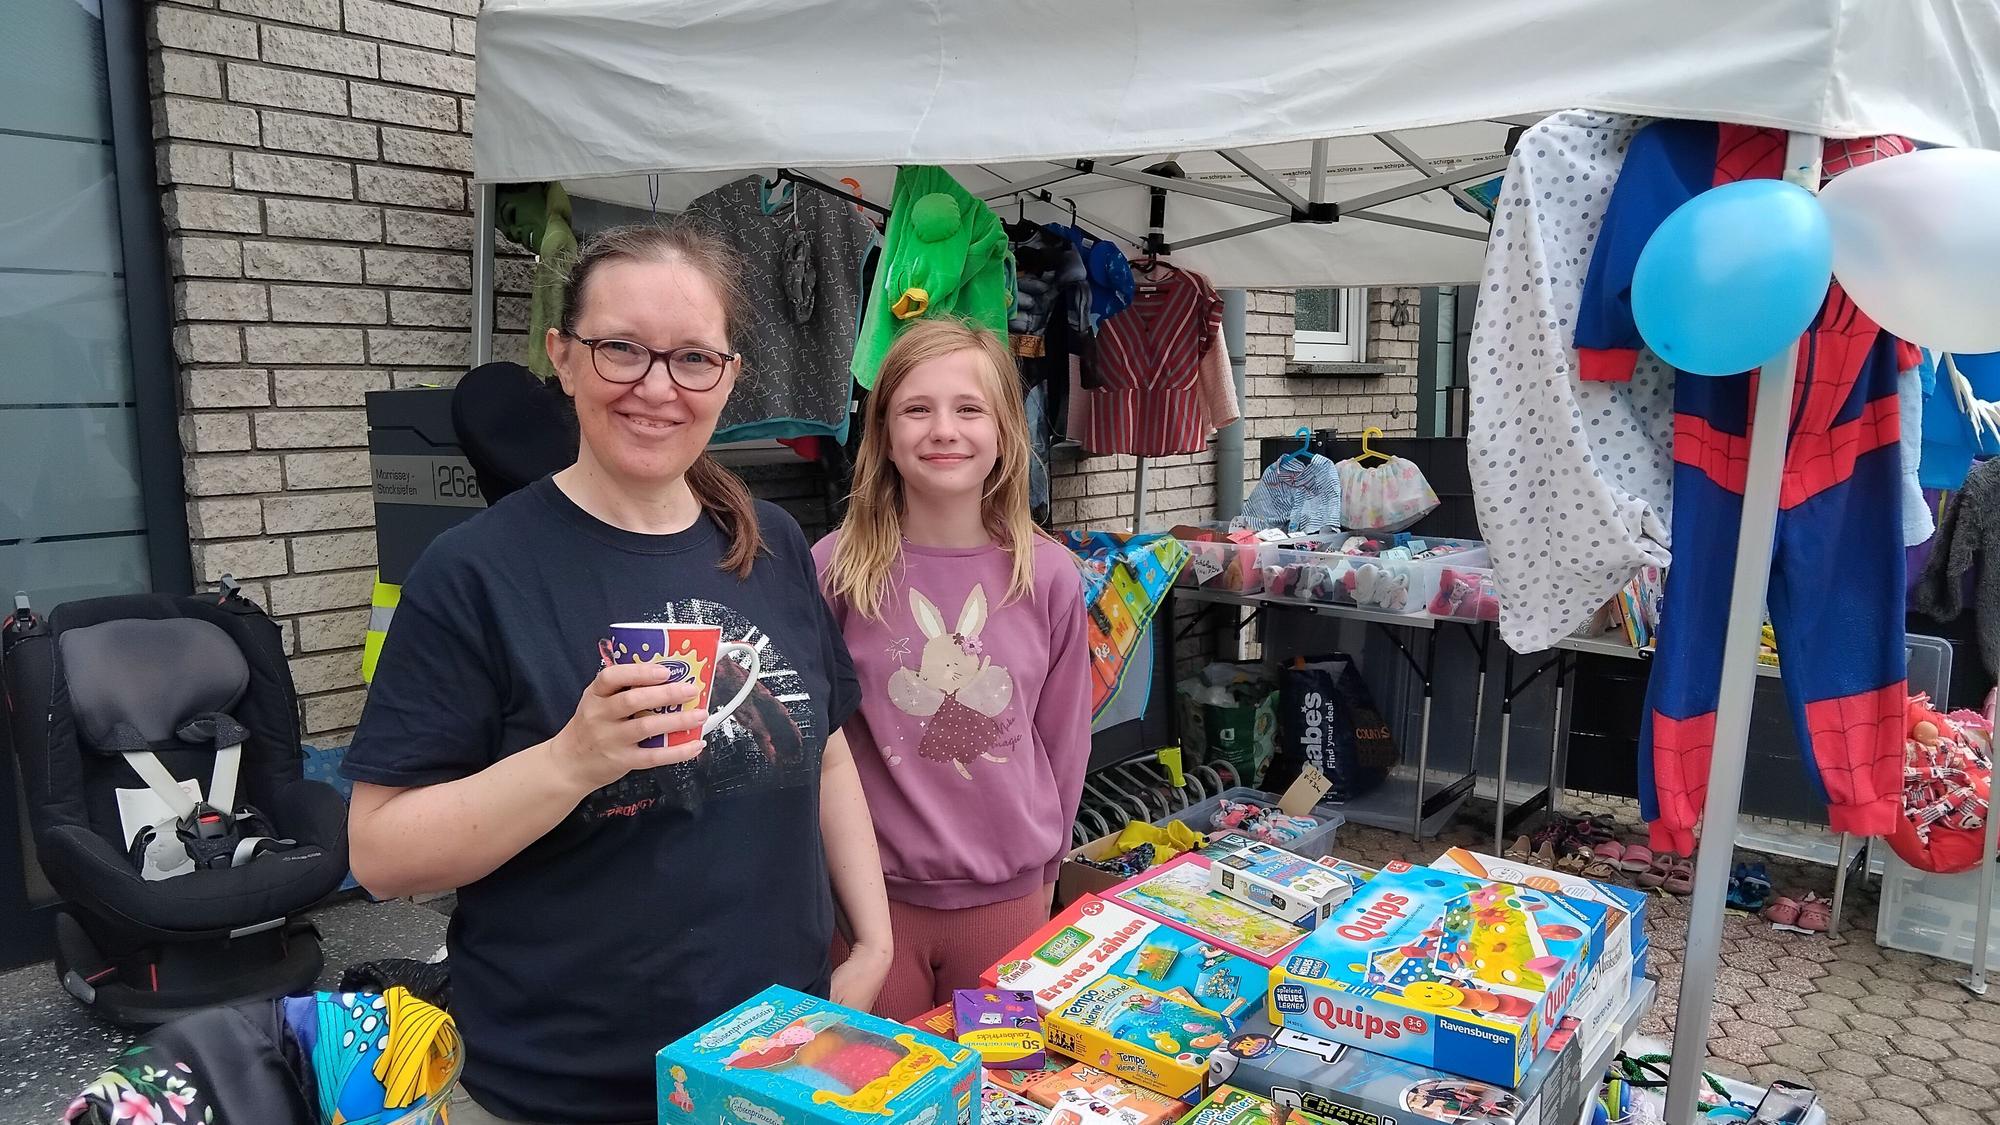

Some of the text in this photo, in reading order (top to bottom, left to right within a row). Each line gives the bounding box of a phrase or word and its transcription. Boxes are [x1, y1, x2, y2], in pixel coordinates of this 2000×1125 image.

[376, 468, 410, 482] Morrissey
[438, 465, 480, 498] 26a
[1325, 699, 1336, 769] Find your deal.
[1083, 903, 1104, 916] 3+
[1336, 892, 1410, 942] Quips
[1035, 918, 1147, 1002] Erstes Zählen
[1276, 986, 1303, 996] spielend
[1276, 994, 1305, 1004] NEUES
[1543, 961, 1578, 1026] Quips
[1061, 988, 1105, 1020] Tempo,
[1277, 1002, 1306, 1010] LERNEN
[1312, 995, 1402, 1040] Quips
[1408, 1019, 1423, 1028] 3-6
[976, 1031, 1032, 1041] Zaubertricks
[1440, 1018, 1510, 1045] Ravensburger
[1022, 1039, 1041, 1050] 50
[1116, 1052, 1148, 1069] Tempo,
[1116, 1064, 1160, 1079] kleine Fische!
